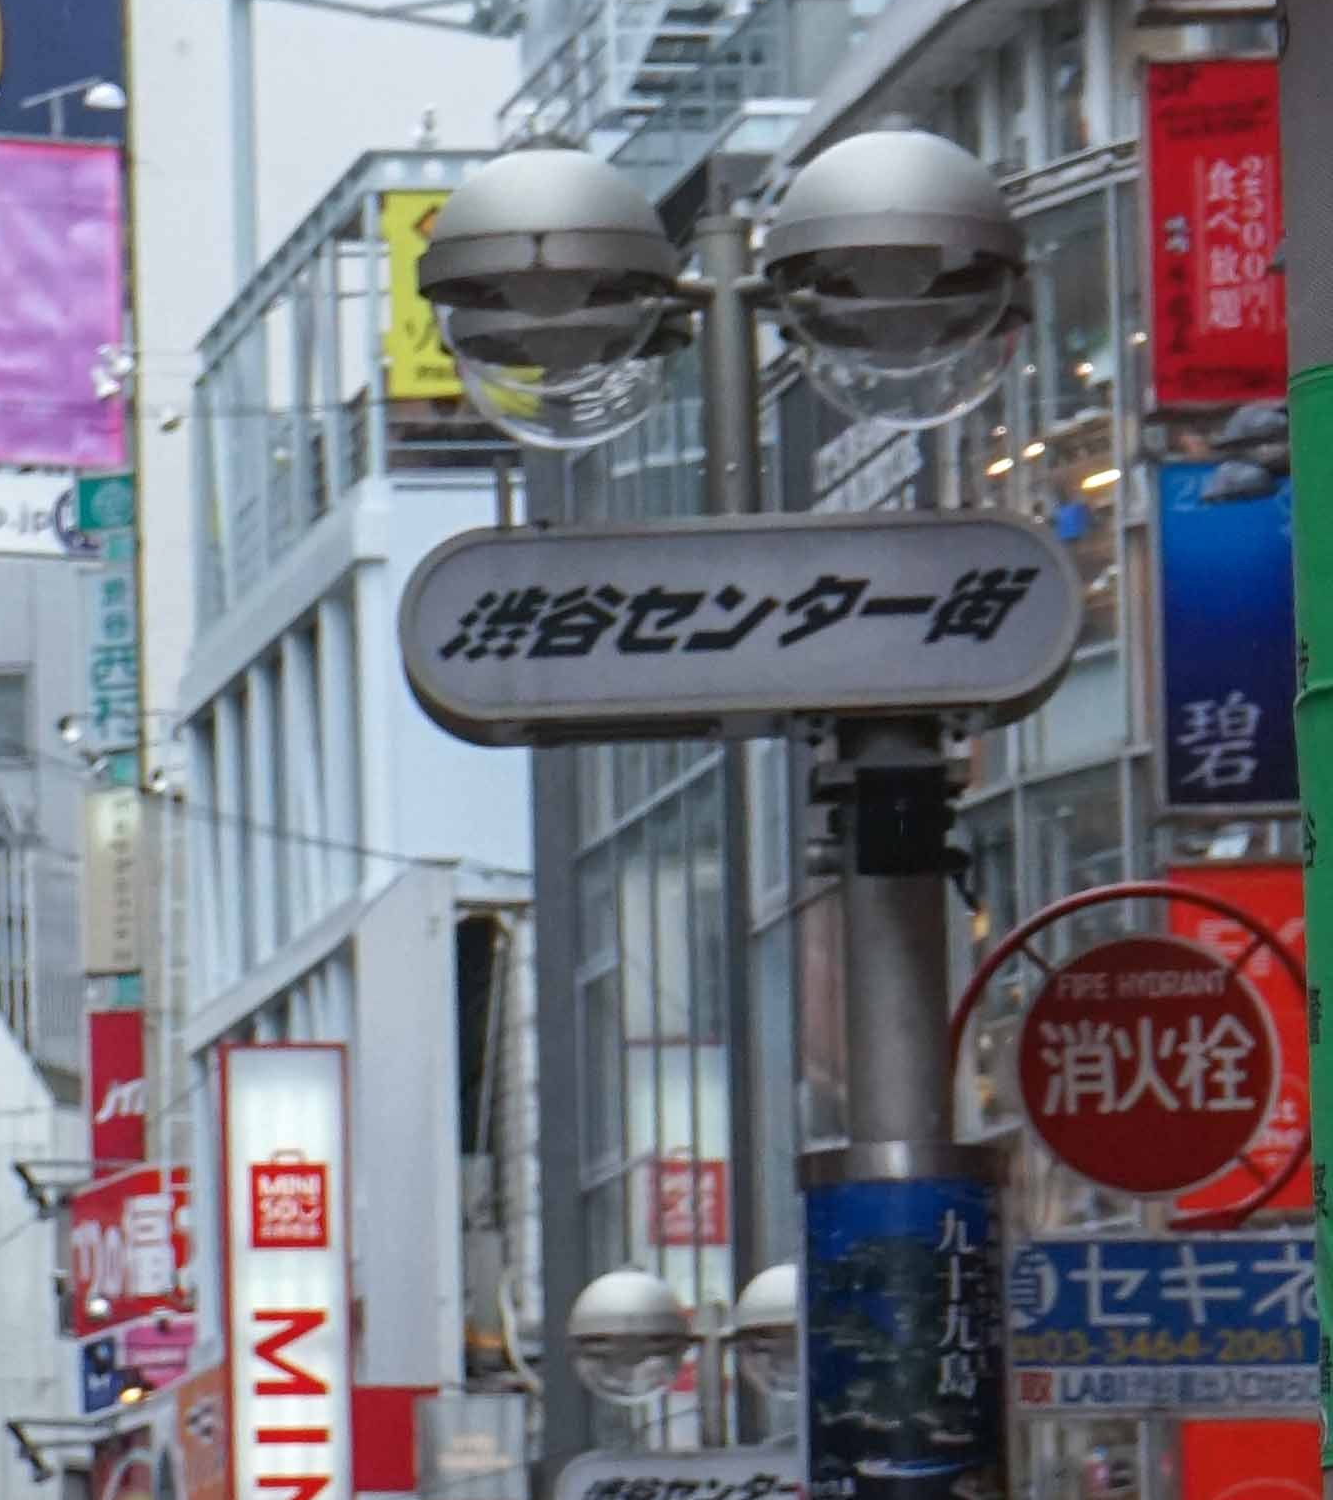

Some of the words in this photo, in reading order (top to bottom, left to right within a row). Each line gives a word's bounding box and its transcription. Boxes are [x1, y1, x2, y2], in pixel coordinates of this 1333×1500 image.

[440, 568, 1043, 662] 渋谷センター街
[1057, 972, 1109, 998] FIRE
[1117, 970, 1227, 1000] HYDRANT
[1039, 1014, 1255, 1118] 消火栓
[935, 1206, 979, 1400] 九十九島
